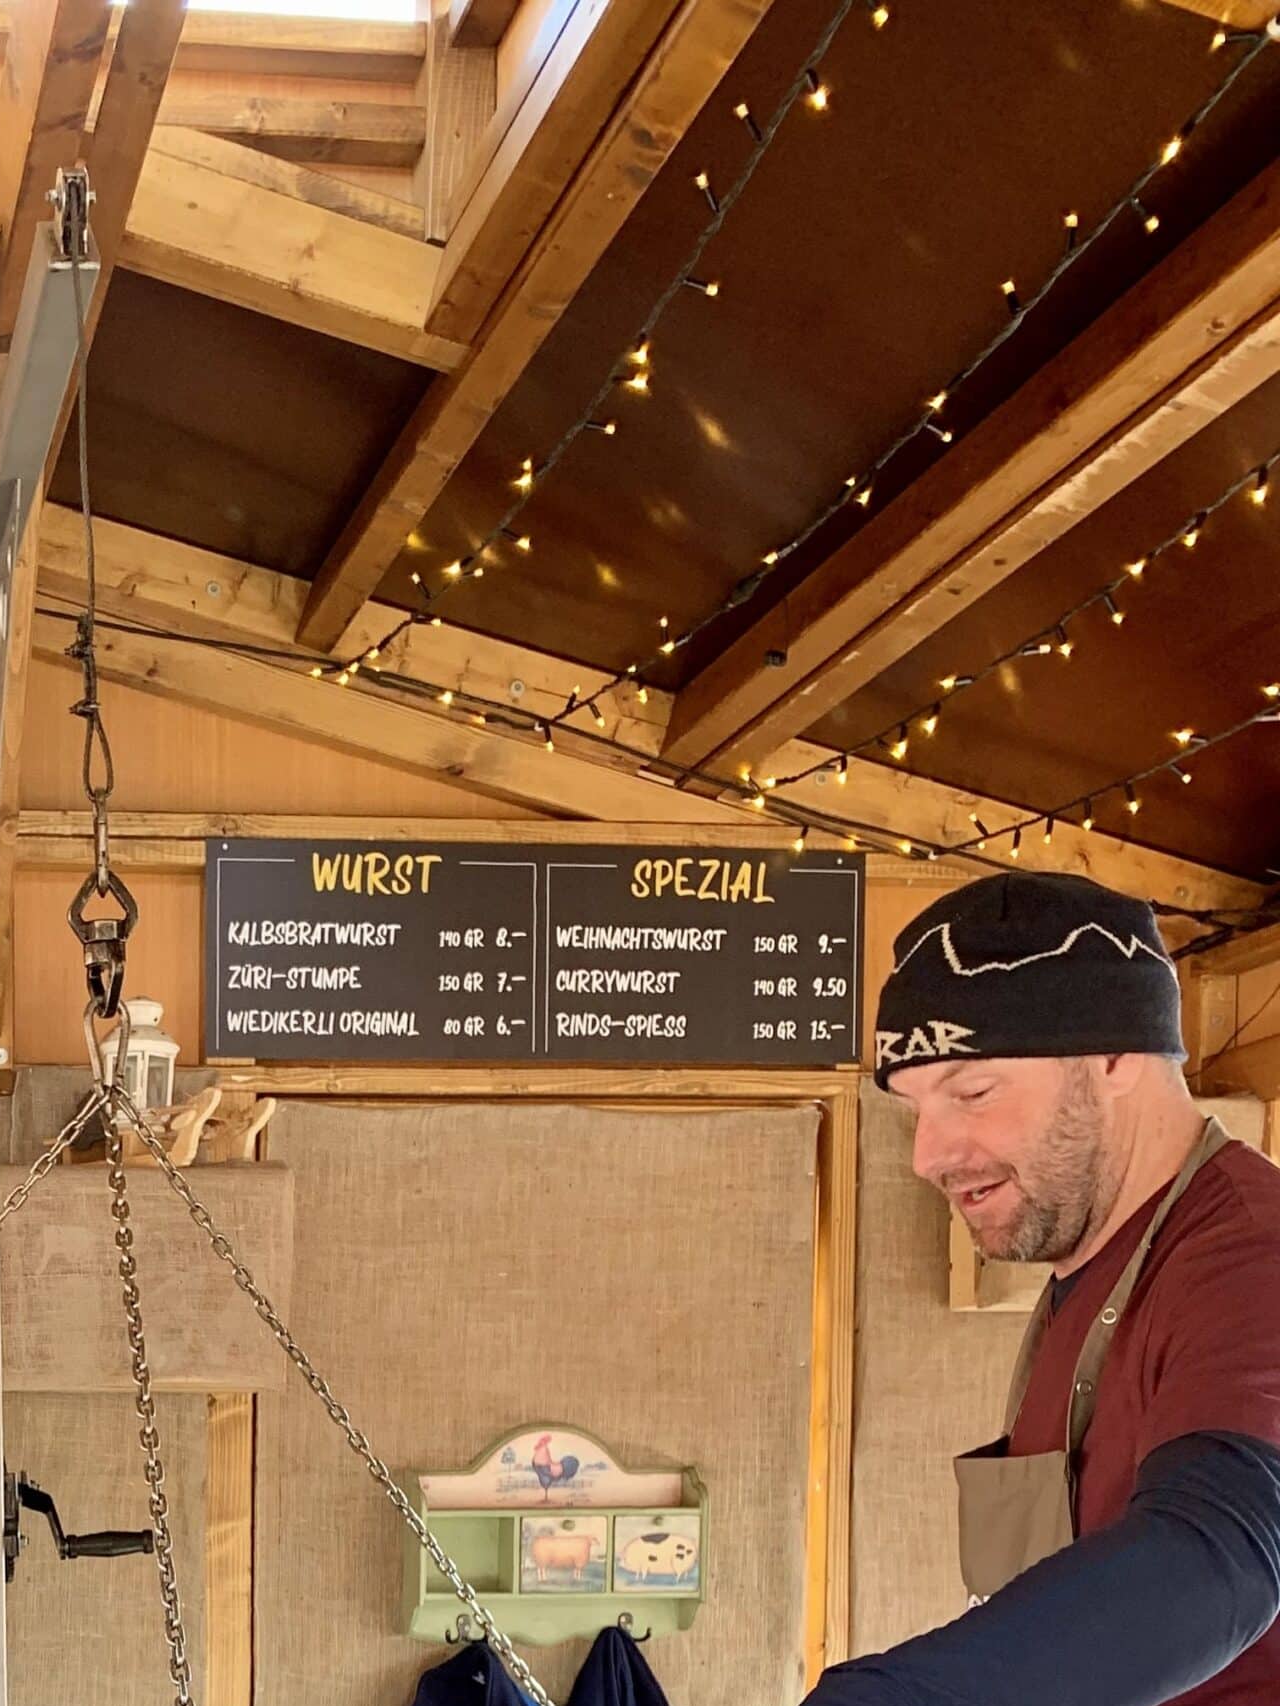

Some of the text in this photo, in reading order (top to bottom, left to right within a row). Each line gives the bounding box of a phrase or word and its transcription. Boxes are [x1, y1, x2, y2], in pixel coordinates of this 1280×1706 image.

[312, 852, 443, 896] WURST
[631, 857, 775, 904] SPEZIAL
[228, 920, 402, 947] KALBSBRATWURST
[439, 930, 461, 948] 140
[463, 927, 485, 949] GR
[556, 925, 728, 952] WEIHNACHTSWURST
[754, 936, 776, 953] 150
[777, 934, 798, 954] GR
[227, 963, 362, 990] ZÜRI-STUMPE
[439, 975, 460, 992] 150
[463, 971, 484, 993] GR
[555, 969, 847, 997] CURRYWURST 140 GR 9.50
[226, 1009, 335, 1036] WIEDIKERLI
[339, 1010, 420, 1037] ORIGINAL
[443, 1018, 461, 1035] 80
[463, 1015, 485, 1037] GR
[555, 1012, 687, 1038] RINDS-SPIESS
[753, 1022, 774, 1039] 150
[776, 1020, 797, 1041] GR
